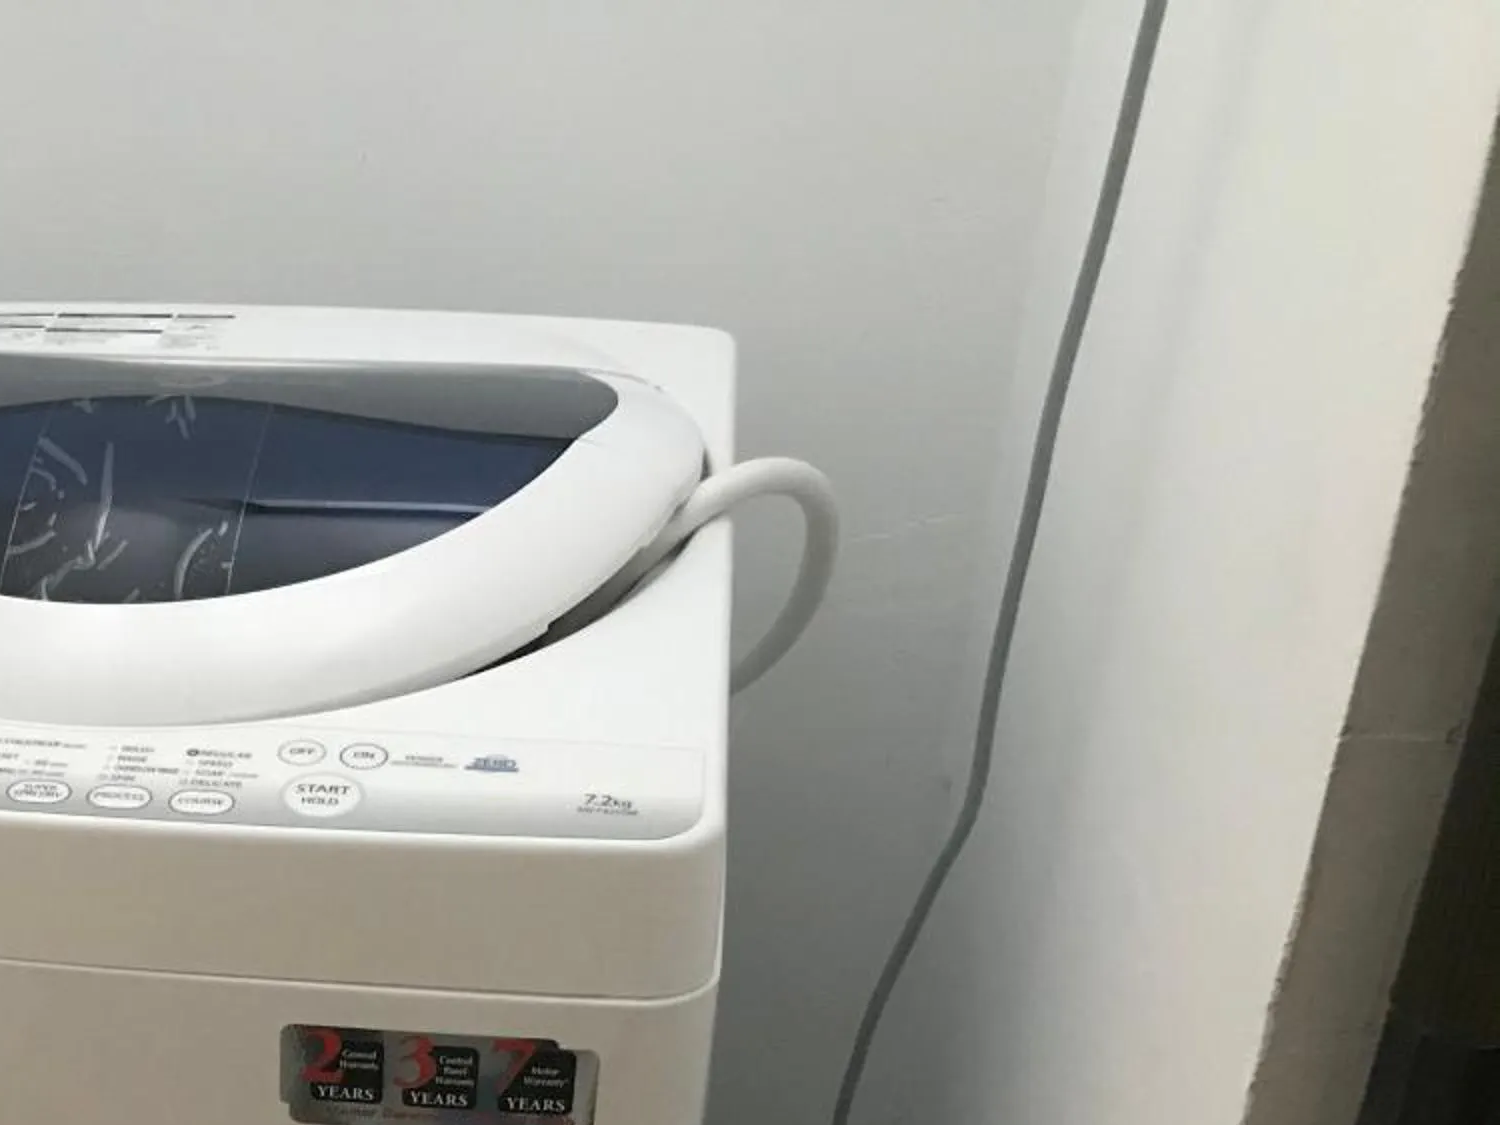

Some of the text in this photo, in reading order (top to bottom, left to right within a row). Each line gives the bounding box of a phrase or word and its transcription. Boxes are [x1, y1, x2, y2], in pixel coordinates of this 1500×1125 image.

[288, 747, 316, 755] OFF
[353, 751, 375, 759] ON
[296, 783, 351, 795] START
[301, 796, 339, 806] HOLD
[300, 1028, 343, 1084] 2
[393, 1035, 438, 1089] 3
[490, 1039, 536, 1095] 7
[316, 1084, 375, 1102] YEARS
[409, 1090, 469, 1107] YEARS
[507, 1096, 566, 1112] YEARS
